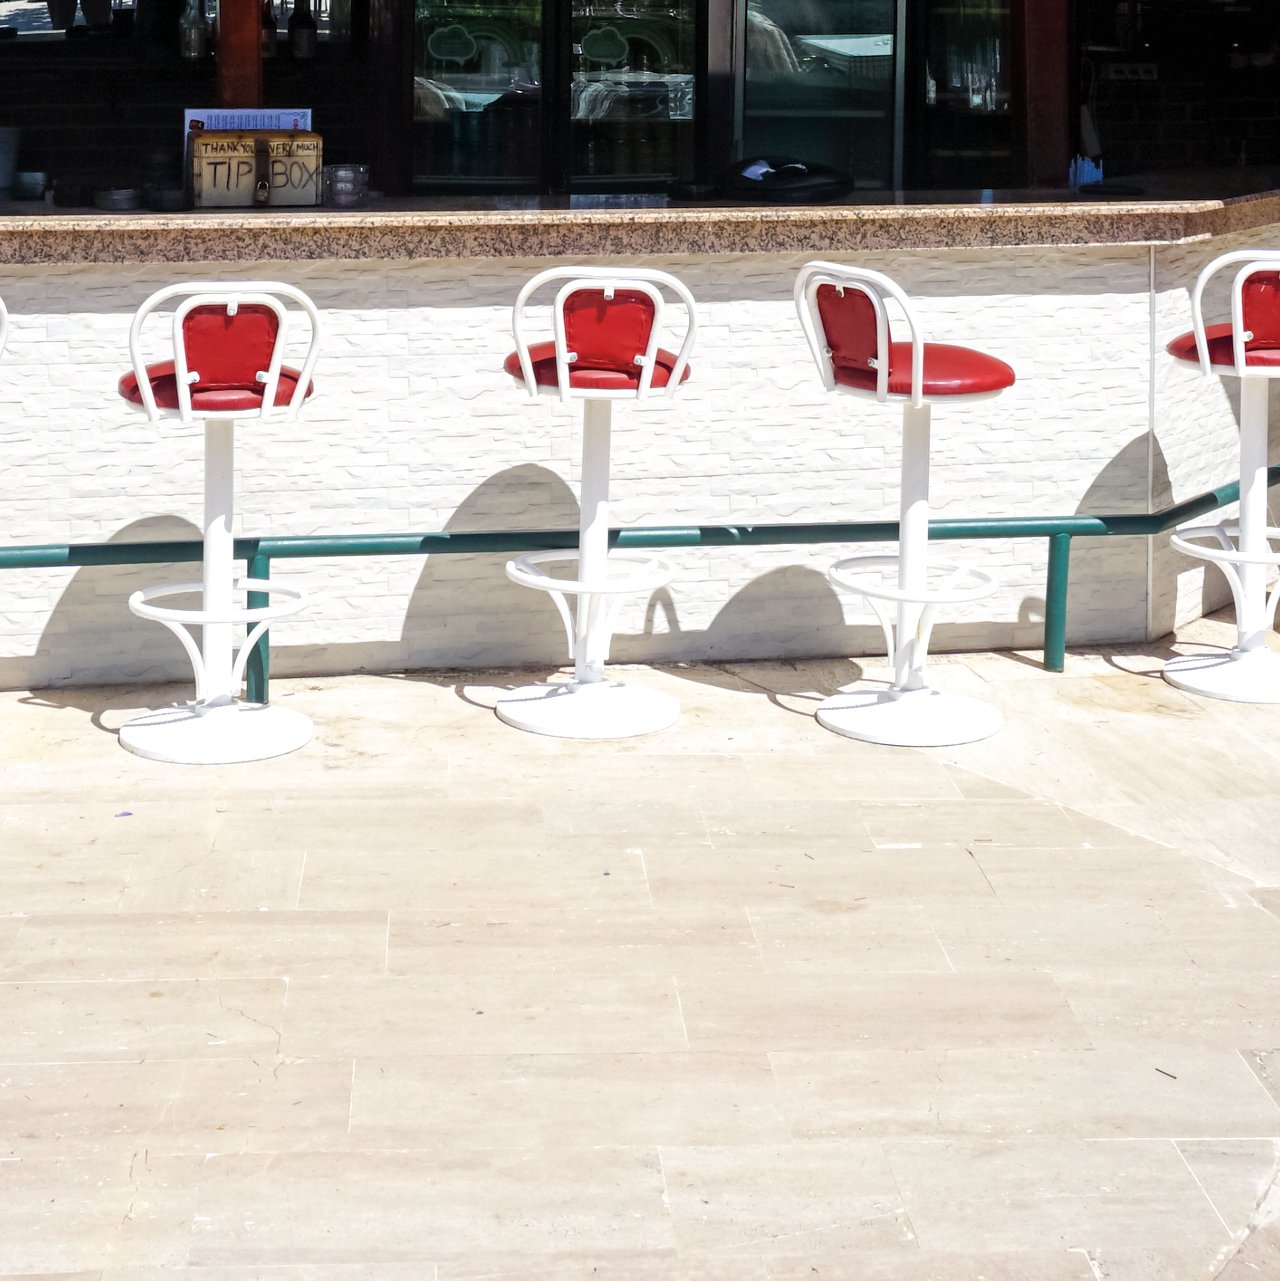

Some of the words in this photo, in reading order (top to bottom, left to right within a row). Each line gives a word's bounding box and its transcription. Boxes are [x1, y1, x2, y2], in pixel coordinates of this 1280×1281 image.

[201, 141, 239, 154] THANK
[295, 143, 319, 153] MUCH
[207, 158, 253, 191] TIP
[270, 159, 320, 190] BOX
